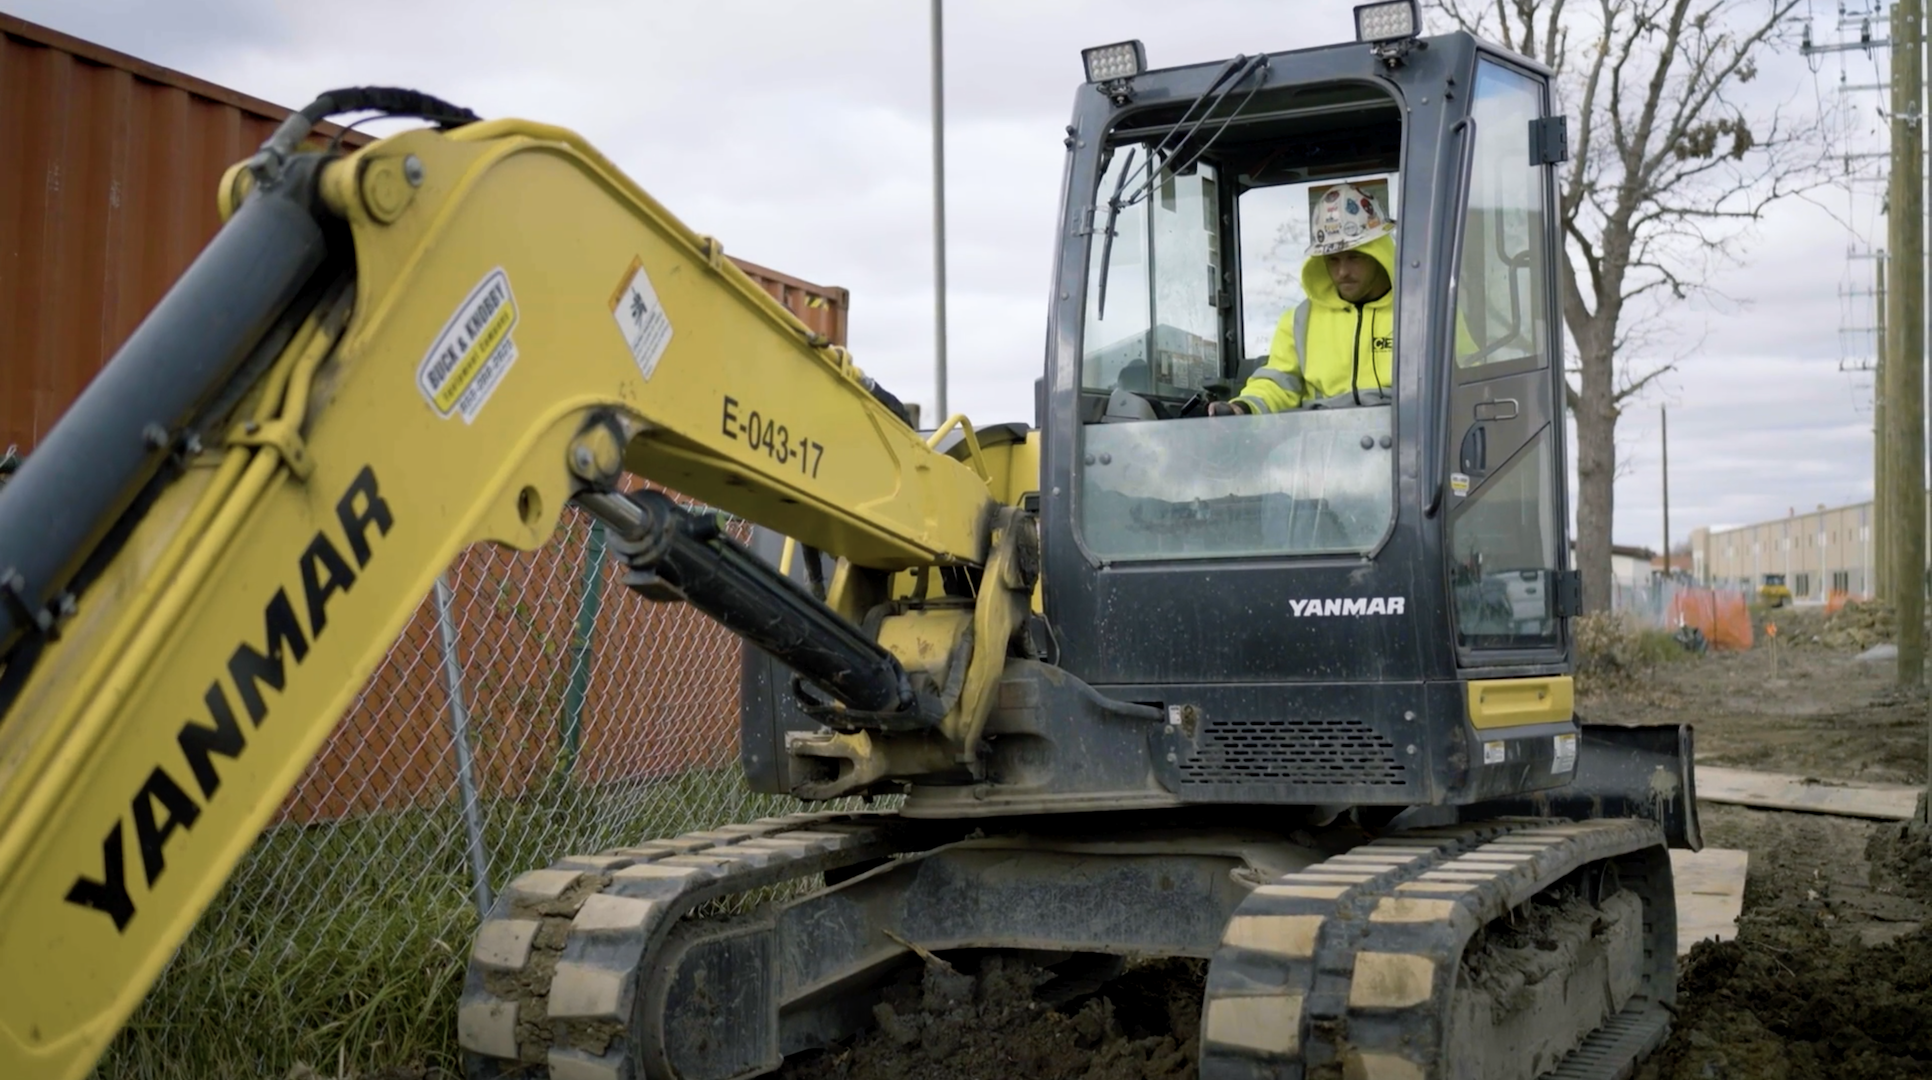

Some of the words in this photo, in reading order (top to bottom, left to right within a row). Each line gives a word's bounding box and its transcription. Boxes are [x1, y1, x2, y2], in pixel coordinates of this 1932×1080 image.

[427, 344, 459, 390] BUCK
[458, 336, 468, 353] &
[465, 281, 506, 341] KNOBBY
[722, 394, 824, 480] E-043-17
[1288, 596, 1406, 617] YANMAR
[64, 463, 395, 935] YANMAR
